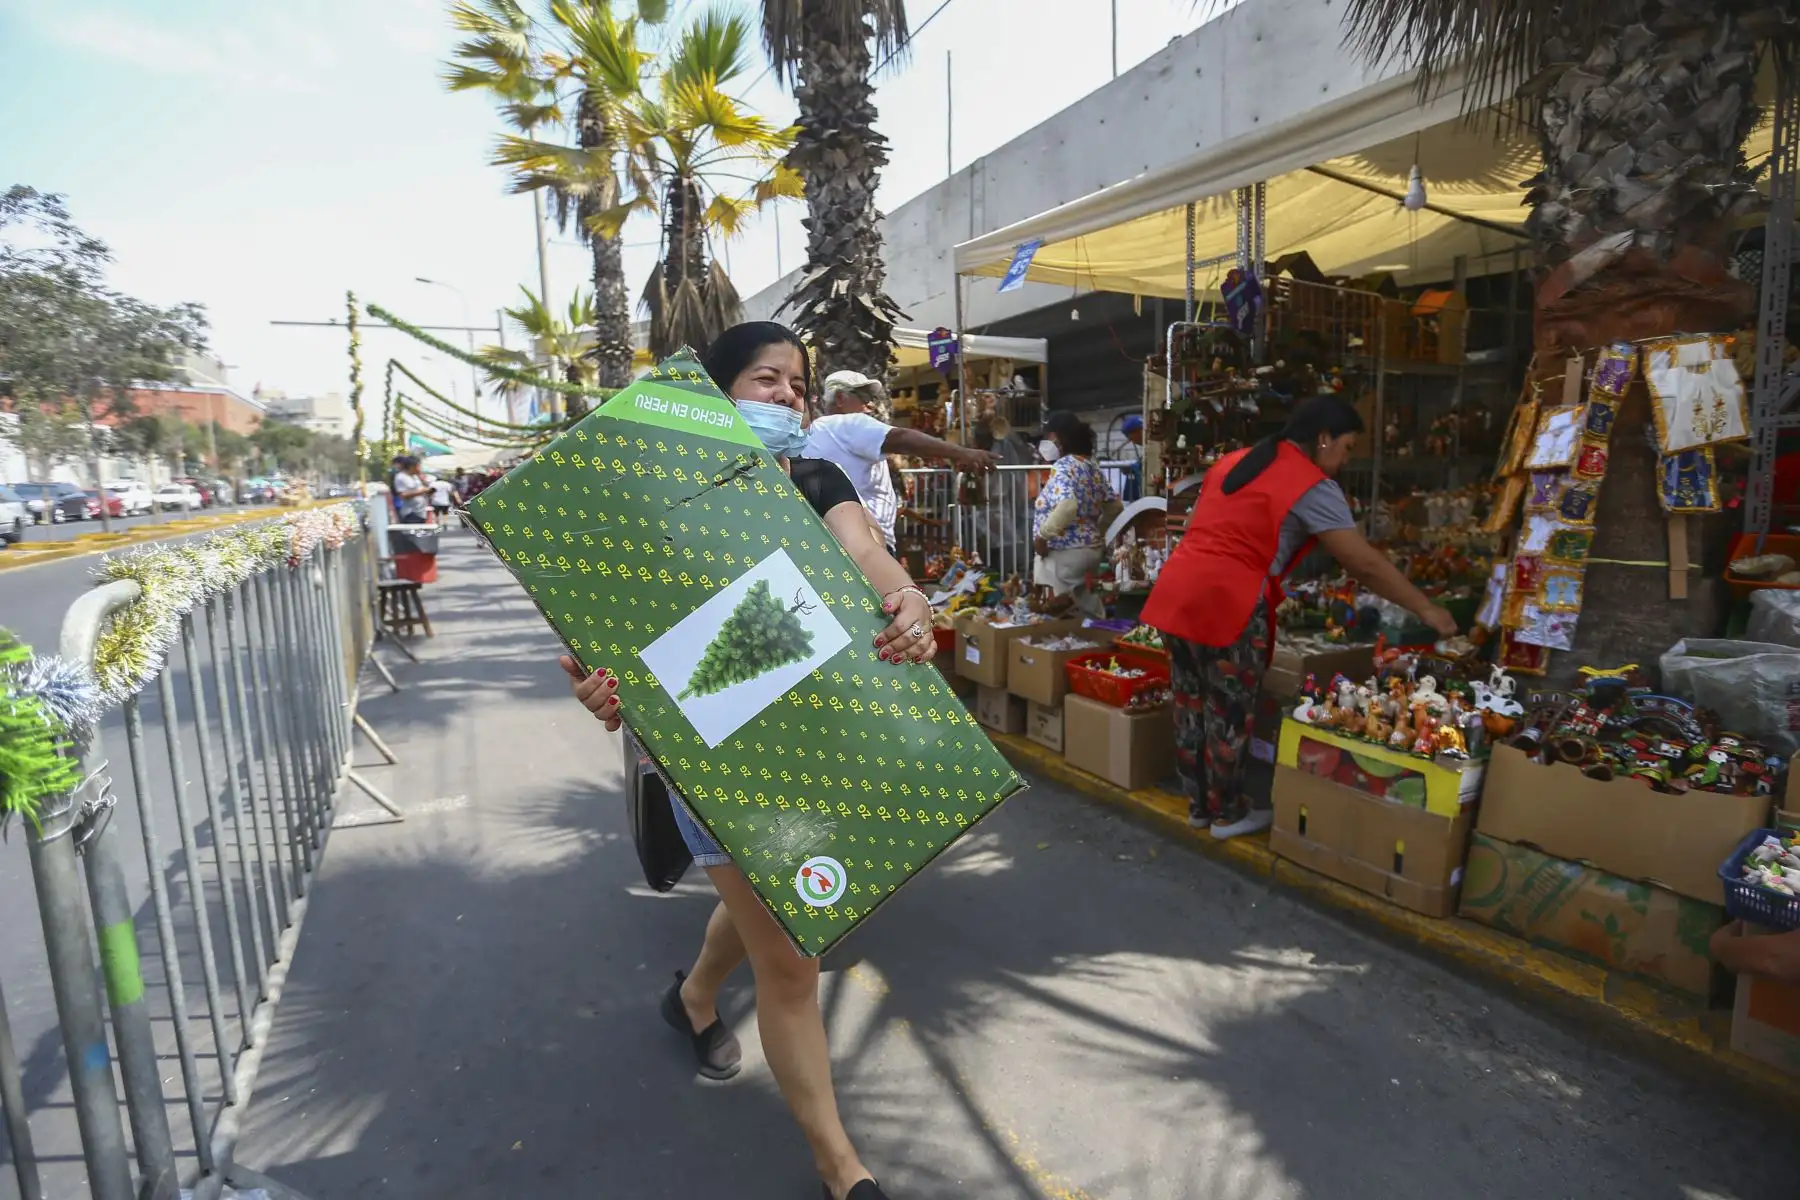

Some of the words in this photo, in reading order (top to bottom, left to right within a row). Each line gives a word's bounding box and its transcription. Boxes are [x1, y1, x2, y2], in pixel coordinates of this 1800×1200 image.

[668, 366, 681, 382] ZG
[688, 369, 703, 385] ZG
[634, 394, 669, 414] PERU
[671, 402, 688, 418] EN
[690, 407, 733, 428] HECHO
[576, 430, 587, 442] ZG
[596, 433, 608, 446] ZG
[616, 436, 629, 448] ZG
[636, 438, 648, 451] ZG
[656, 441, 668, 454] ZG
[676, 442, 688, 456] ZG
[551, 451, 565, 466] ZG
[696, 448, 708, 460] ZG
[716, 450, 728, 463] ZG
[735, 454, 749, 466] ZG
[571, 454, 587, 469] ZG
[592, 457, 606, 472] ZG
[612, 459, 628, 476] ZG
[756, 457, 767, 469] ZG
[632, 462, 648, 477] ZG
[651, 463, 667, 480] ZG
[672, 468, 688, 483] ZG
[693, 471, 710, 486] ZG
[734, 477, 748, 492] ZG
[754, 480, 768, 496] ZG
[773, 484, 788, 499] ZG
[558, 506, 568, 518] ZG
[484, 522, 495, 534] ZG
[503, 524, 515, 536] ZG
[523, 526, 535, 539] ZG
[542, 529, 554, 543] ZG
[562, 531, 574, 544] ZG
[581, 533, 594, 547] ZG
[602, 537, 614, 549] ZG
[622, 540, 634, 552] ZG
[641, 542, 654, 555] ZG
[661, 543, 675, 557] ZG
[681, 546, 694, 560] ZG
[517, 551, 533, 566] ZG
[537, 553, 551, 568] ZG
[703, 551, 716, 562] ZG
[723, 552, 735, 565] ZG
[744, 556, 755, 568] ZG
[555, 556, 571, 573] ZG
[577, 559, 592, 574] ZG
[596, 561, 612, 577] ZG
[803, 565, 815, 577] ZG
[617, 564, 632, 580] ZG
[637, 567, 652, 582] ZG
[657, 568, 673, 585] ZG
[823, 568, 834, 580] ZG
[842, 571, 854, 583] ZG
[678, 572, 693, 588] ZG
[699, 575, 714, 590] ZG
[821, 592, 835, 607] ZG
[841, 594, 854, 610] ZG
[862, 598, 874, 613] ZG
[570, 638, 581, 651] ZG
[590, 641, 602, 653] ZG
[610, 644, 622, 656] ZG
[625, 671, 639, 686] ZG
[645, 672, 661, 688] ZG
[832, 672, 844, 683] ZG
[852, 674, 863, 688] ZG
[872, 677, 884, 689] ZG
[891, 679, 902, 691] ZG
[909, 680, 920, 694] ZG
[929, 683, 940, 696] ZG
[789, 691, 804, 707] ZG
[809, 694, 823, 709] ZG
[829, 696, 844, 712] ZG
[848, 697, 864, 714] ZG
[869, 701, 884, 716] ZG
[889, 704, 903, 719] ZG
[909, 706, 922, 721] ZG
[928, 708, 941, 723] ZG
[946, 710, 960, 725] ZG
[964, 712, 977, 728] ZG
[679, 758, 691, 770] ZG
[698, 760, 711, 773] ZG
[720, 763, 731, 775] ZG
[740, 765, 751, 778] ZG
[760, 768, 772, 780] ZG
[780, 771, 792, 783] ZG
[801, 773, 812, 785] ZG
[819, 775, 832, 788] ZG
[841, 778, 852, 790] ZG
[861, 780, 872, 792] ZG
[692, 785, 708, 800] ZG
[712, 787, 728, 803] ZG
[880, 782, 892, 794] ZG
[900, 784, 911, 796] ZG
[919, 786, 930, 798] ZG
[936, 788, 950, 799] ZG
[957, 789, 968, 801] ZG
[735, 790, 751, 806] ZG
[755, 793, 770, 808] ZG
[776, 795, 790, 811] ZG
[976, 791, 986, 803] ZG
[796, 797, 810, 813] ZG
[816, 800, 832, 815] ZG
[836, 802, 851, 817] ZG
[857, 804, 871, 820] ZG
[877, 806, 892, 821] ZG
[896, 808, 911, 823] ZG
[917, 810, 931, 825] ZG
[936, 812, 951, 826] ZG
[953, 812, 967, 828] ZG
[845, 856, 854, 868] ZG
[768, 873, 780, 887] ZG
[849, 883, 863, 894] ZG
[784, 900, 798, 918] ZG
[844, 907, 859, 921] ZG
